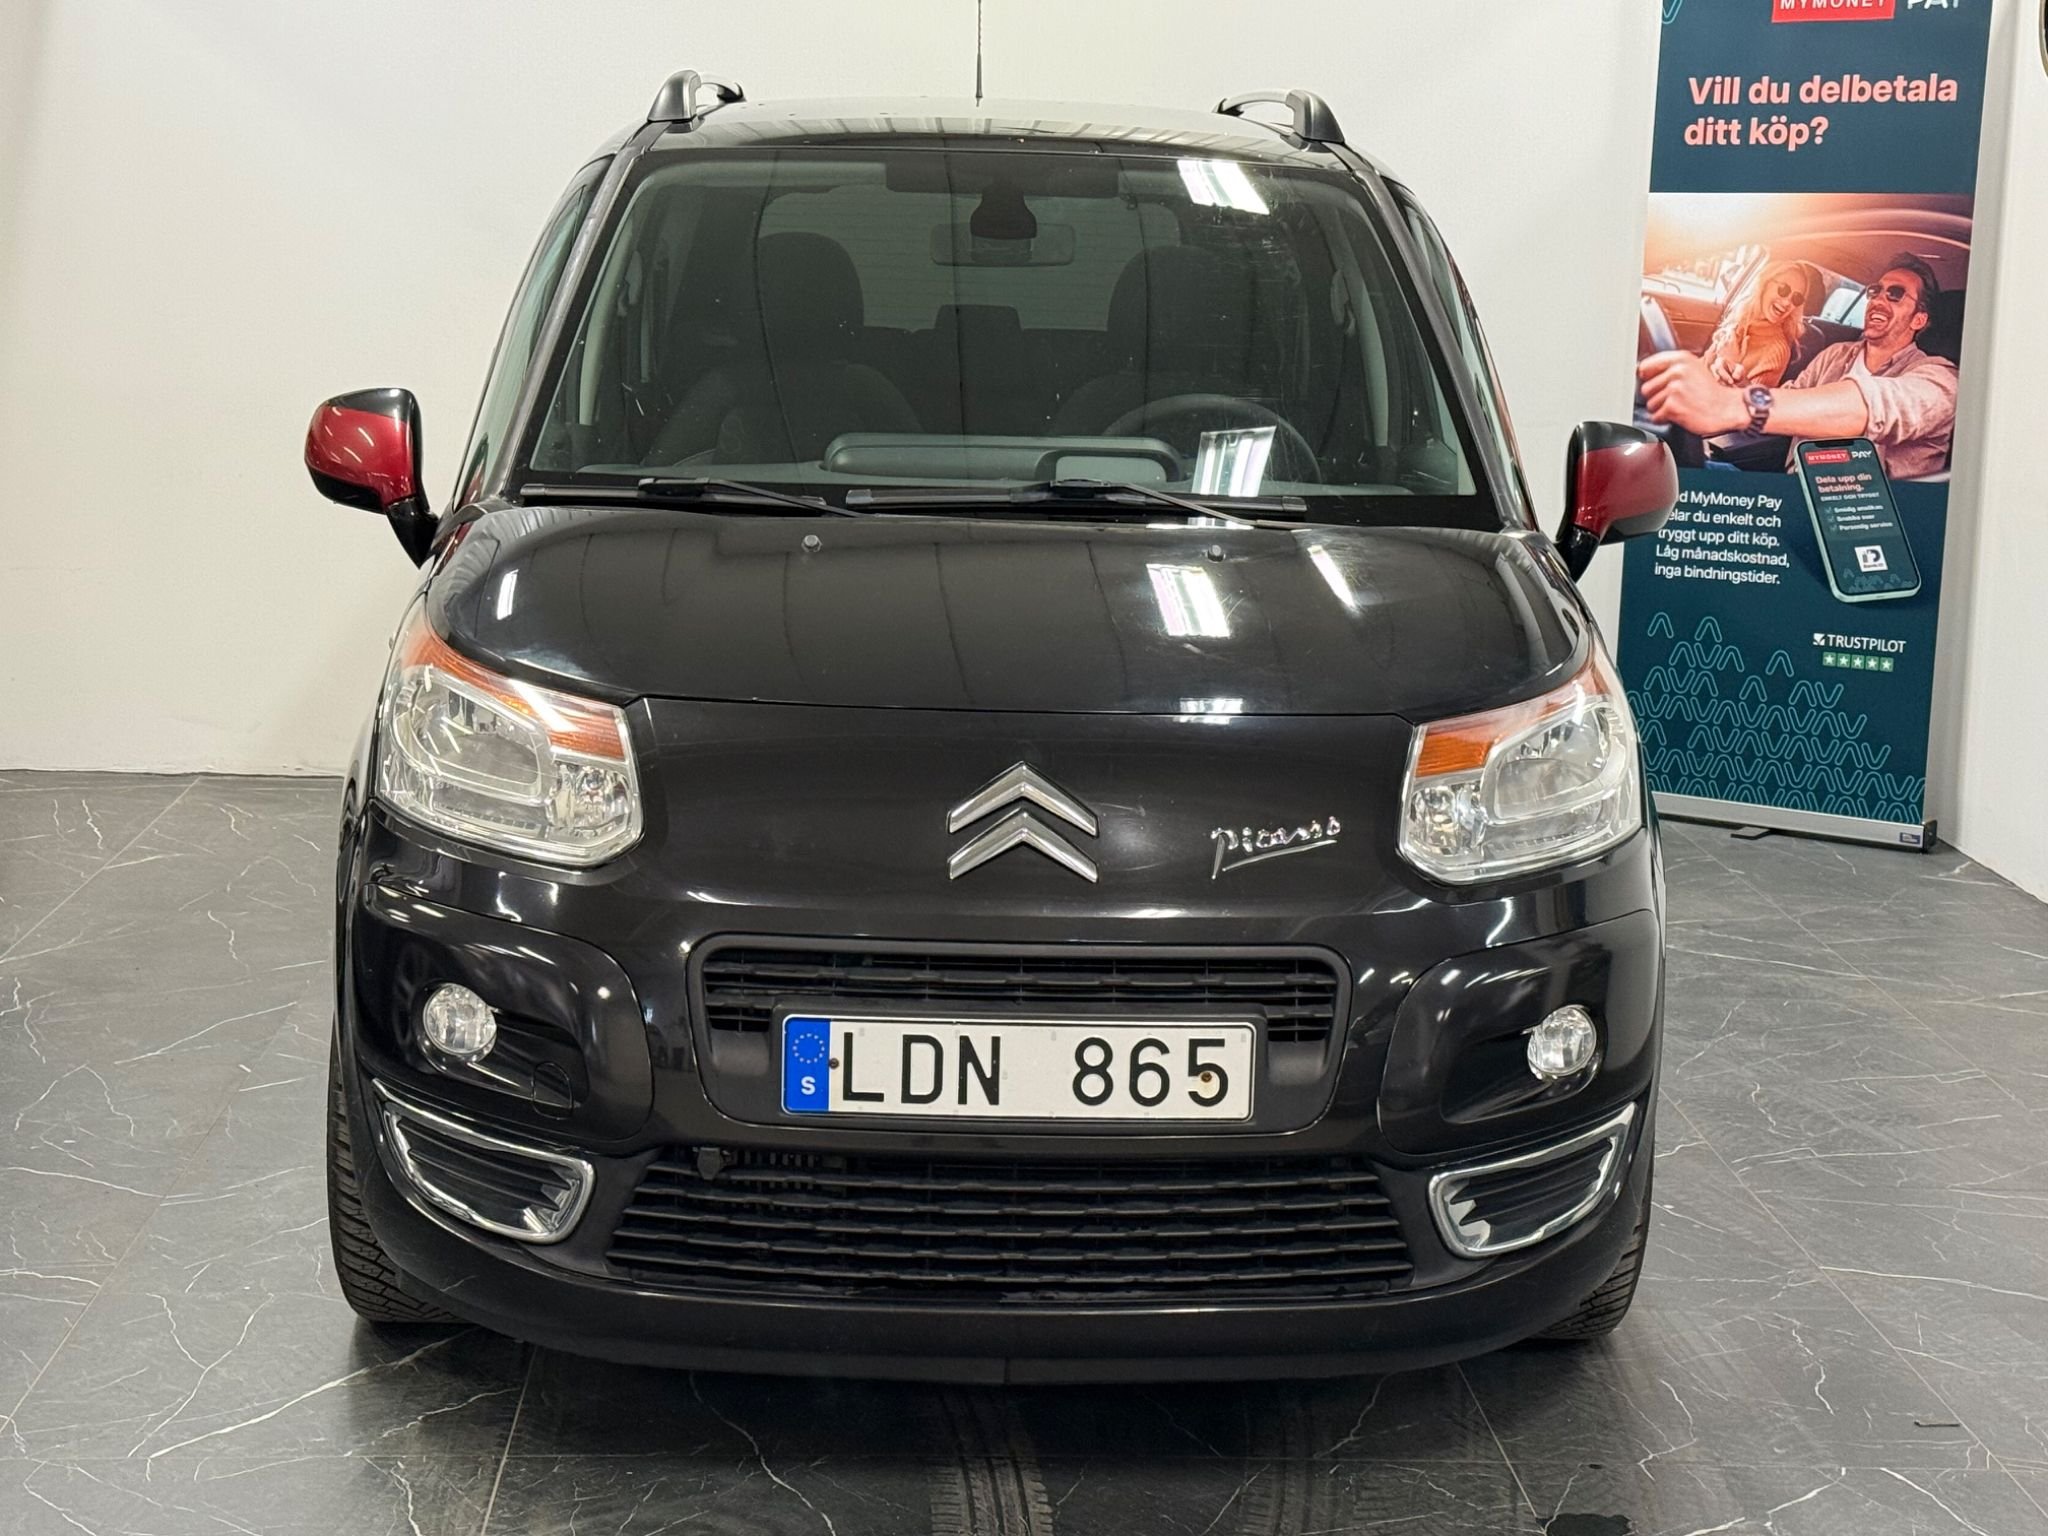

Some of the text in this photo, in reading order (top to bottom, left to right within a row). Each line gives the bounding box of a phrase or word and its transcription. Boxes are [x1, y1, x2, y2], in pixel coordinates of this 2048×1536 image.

[1688, 73, 1958, 105] Vill du delbetala
[1683, 115, 1829, 152] ditt köp?
[1851, 450, 1872, 458] PAY
[1815, 472, 1872, 484] Dela upp din
[1818, 483, 1864, 493] betalning.
[1690, 490, 1755, 510] MyMoney
[1757, 494, 1782, 512] Pay
[1668, 508, 1781, 528] elar du enkelt och
[1698, 531, 1725, 545] upp
[1727, 530, 1750, 544] ditt
[1752, 532, 1780, 549] köp.
[1656, 544, 1790, 568] Låg månadskostnad,
[1654, 562, 1780, 584] inga bindningstider.
[1827, 634, 1907, 653] TRUSTPILOT
[842, 1031, 1229, 1107] LDN 865
[800, 1075, 816, 1095] S
